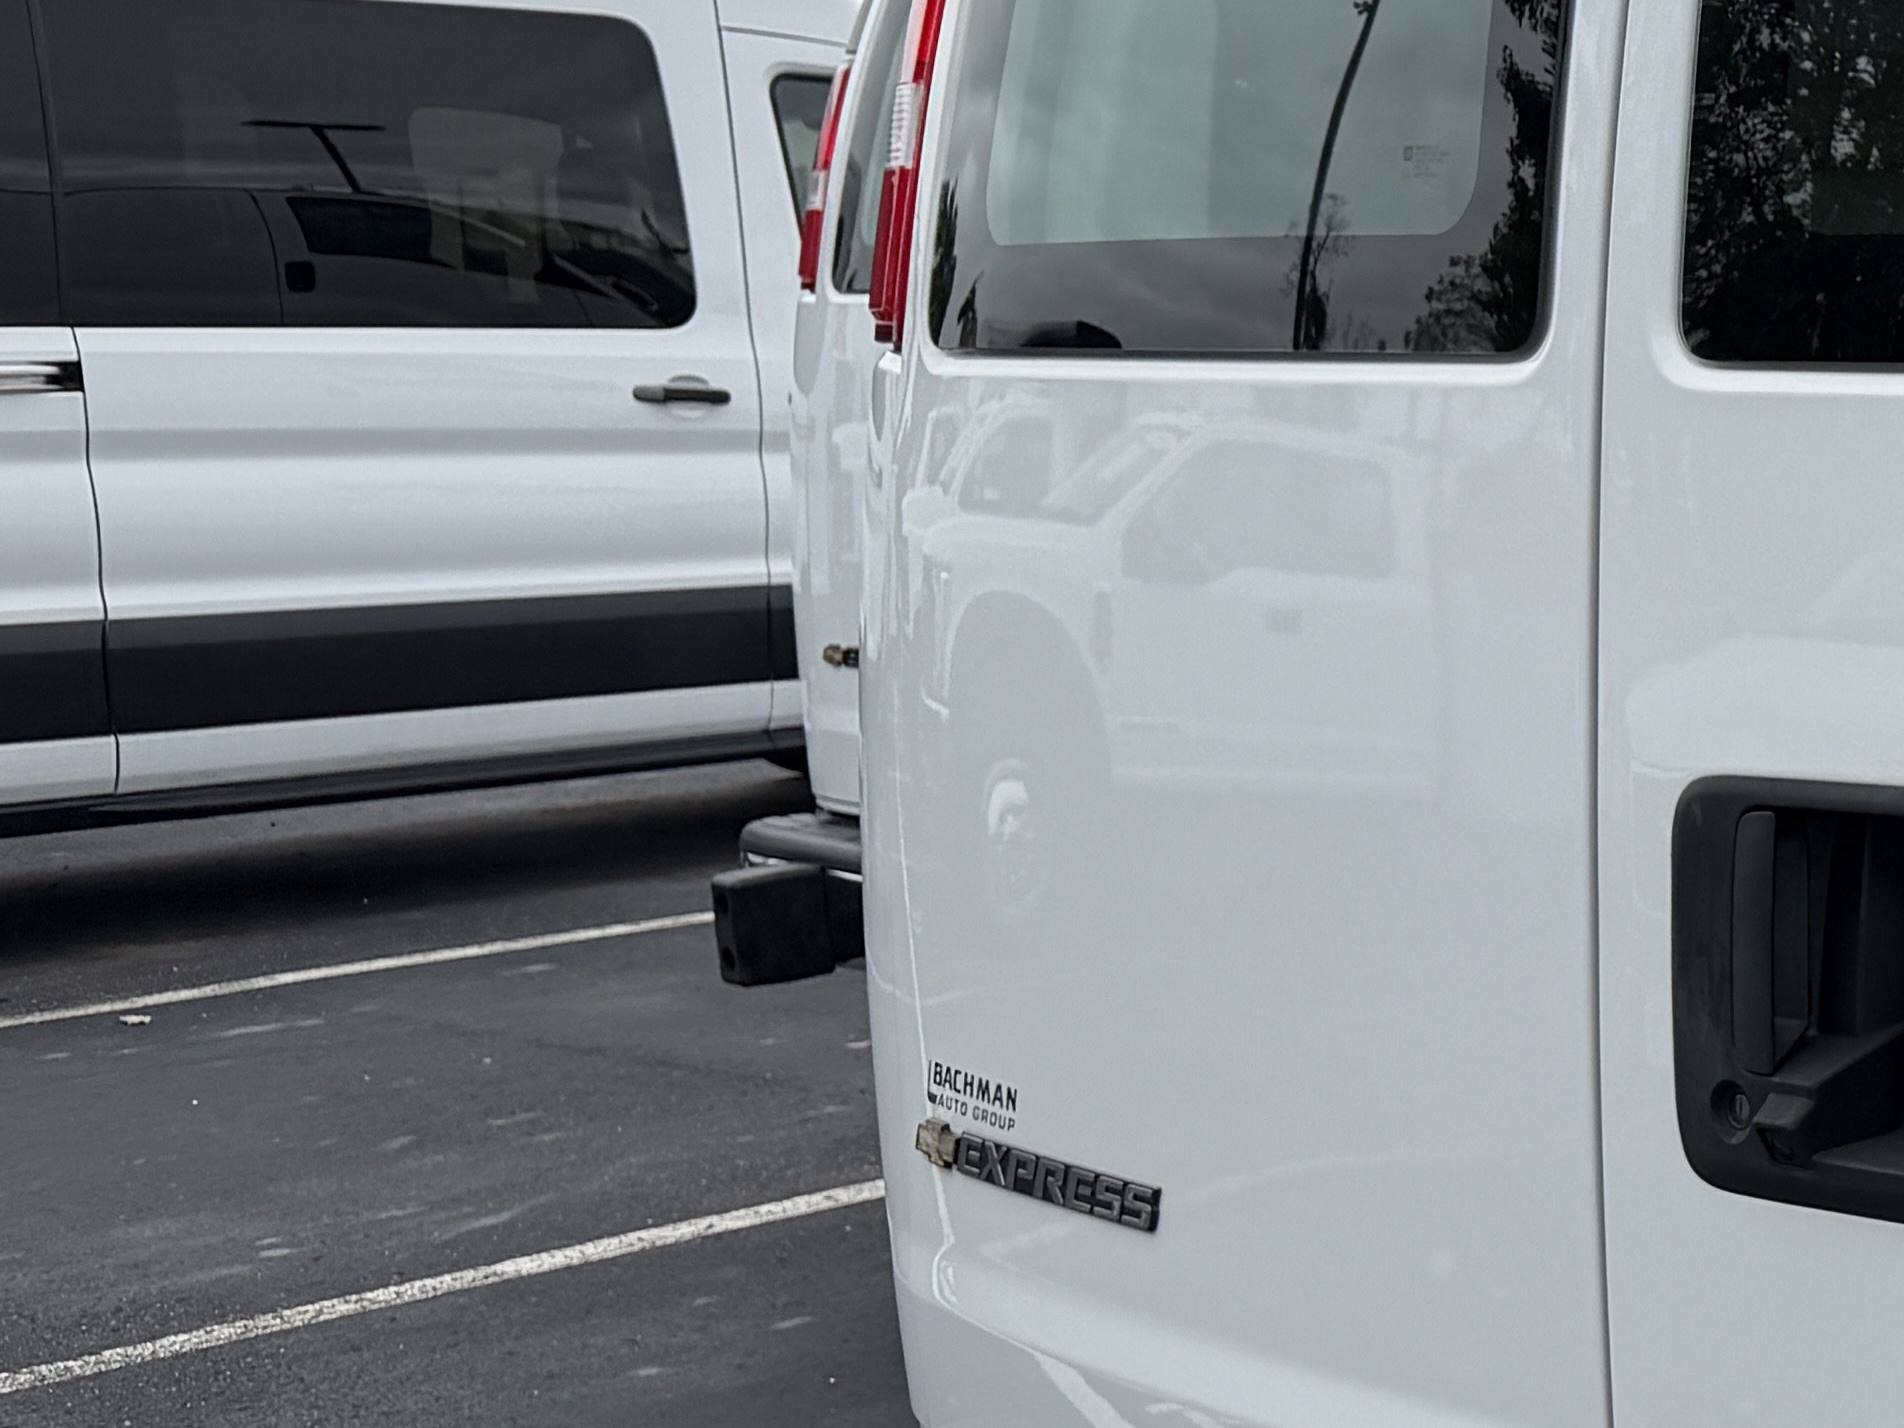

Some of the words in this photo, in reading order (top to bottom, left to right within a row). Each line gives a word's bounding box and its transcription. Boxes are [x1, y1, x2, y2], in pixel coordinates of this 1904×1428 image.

[931, 1060, 1019, 1114] BACHMAN
[936, 1091, 969, 1117] AUTO
[972, 1105, 1017, 1133] GROUP
[956, 1132, 1157, 1231] EXPRESS
